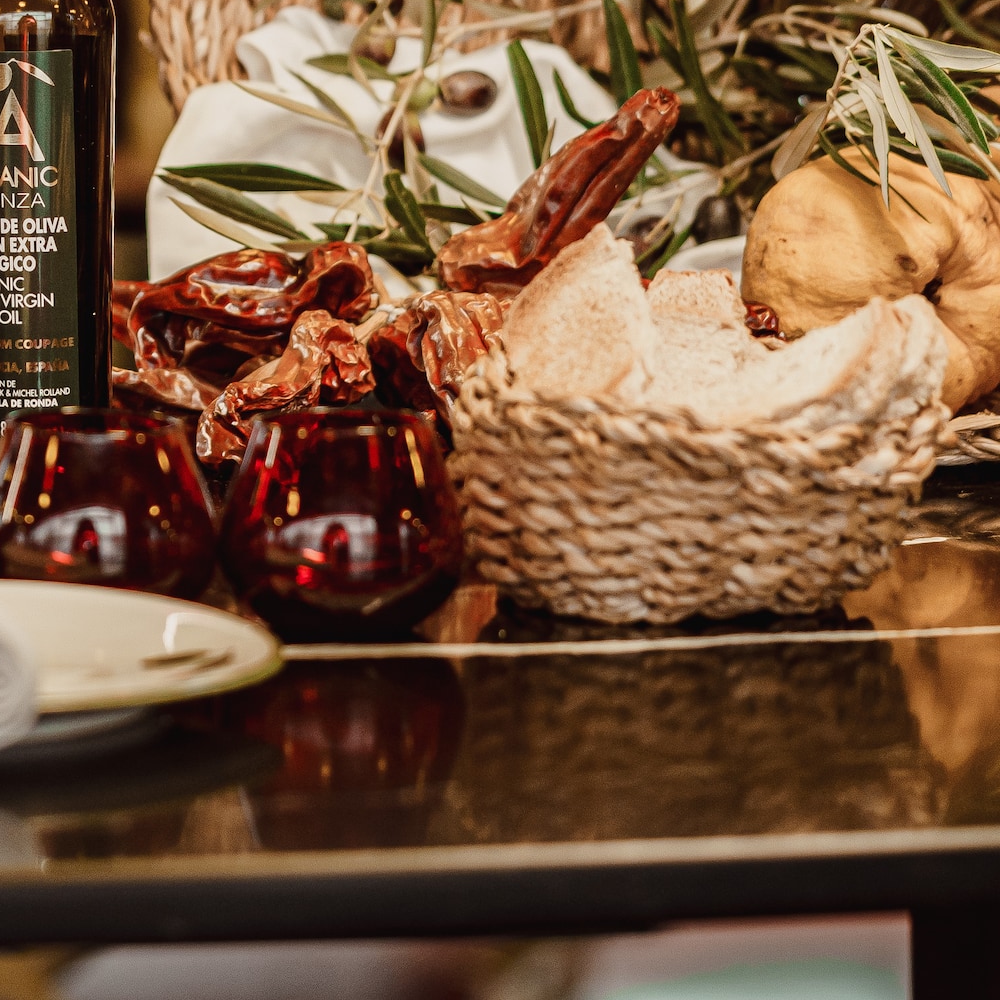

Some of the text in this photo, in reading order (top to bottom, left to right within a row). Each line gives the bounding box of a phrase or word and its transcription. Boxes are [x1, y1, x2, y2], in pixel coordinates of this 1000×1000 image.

[0, 218, 18, 234] DE
[22, 216, 68, 234] OLIVA
[9, 235, 58, 253] EXTRA
[0, 293, 55, 308] VIRGIN
[14, 336, 75, 350] COUPAGE
[6, 380, 16, 388] DE
[12, 389, 38, 397] MICHEL
[40, 387, 71, 397] ROLLAND
[11, 399, 22, 408] DE
[24, 398, 59, 407] RONDA
